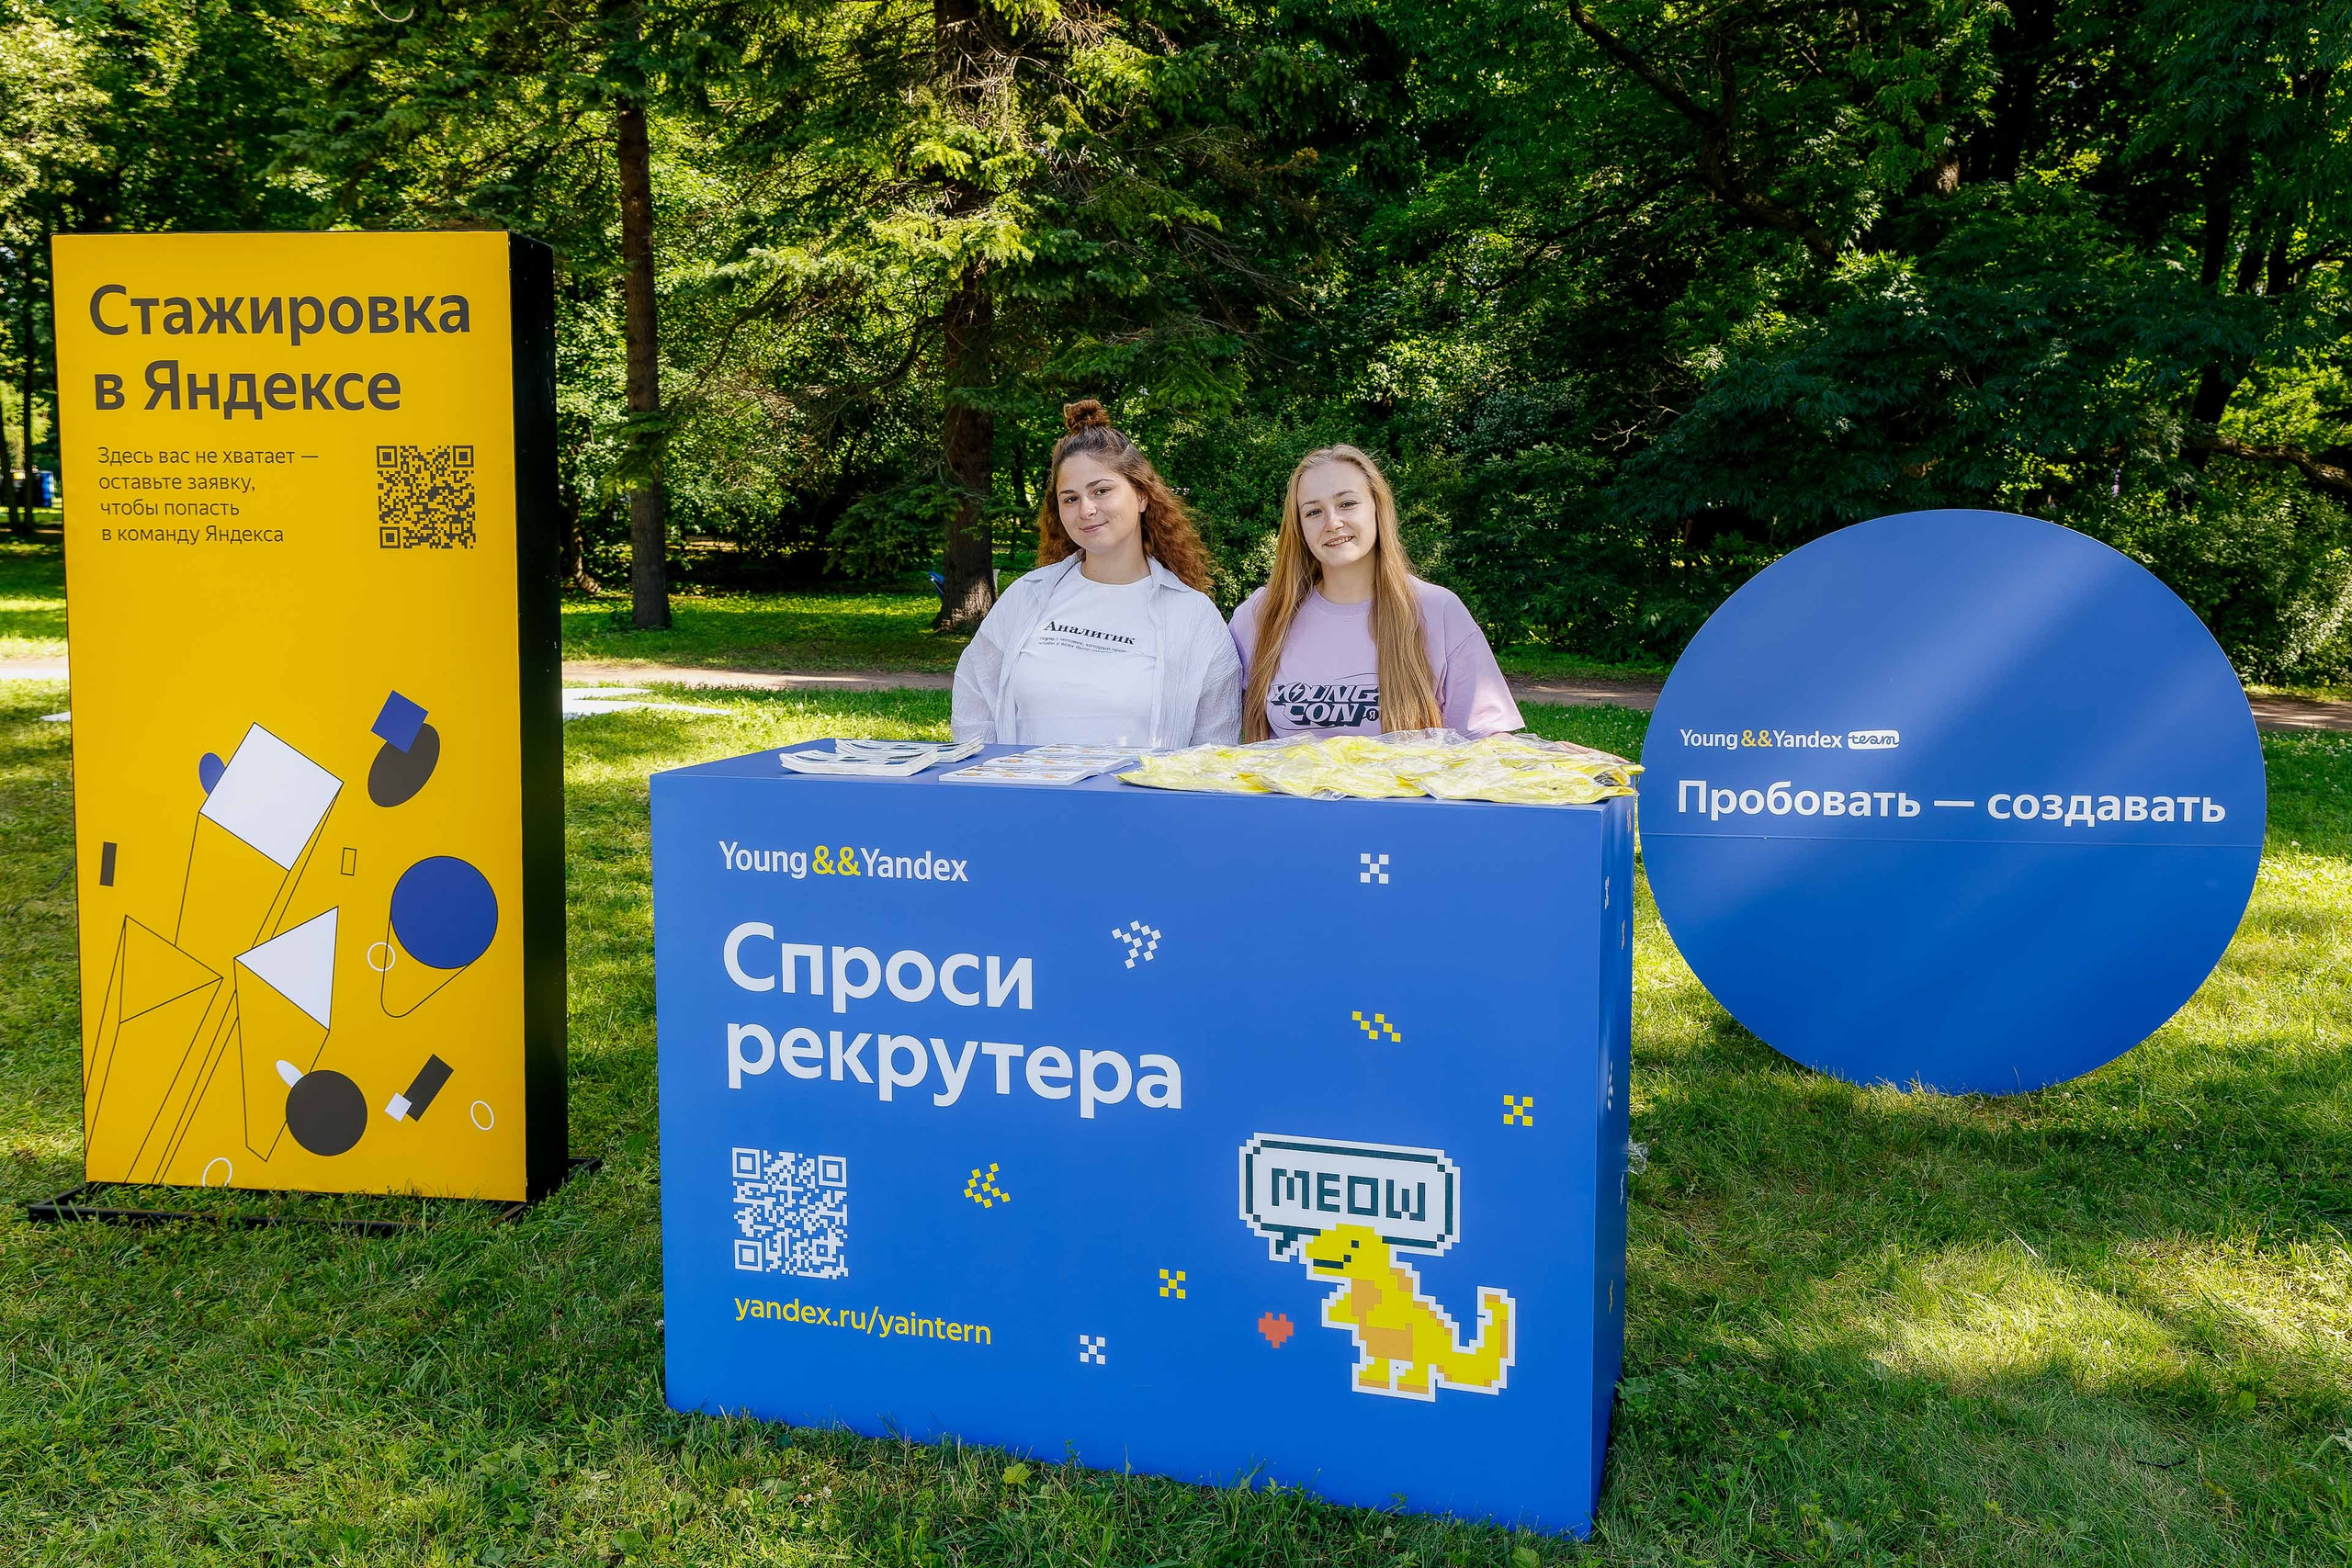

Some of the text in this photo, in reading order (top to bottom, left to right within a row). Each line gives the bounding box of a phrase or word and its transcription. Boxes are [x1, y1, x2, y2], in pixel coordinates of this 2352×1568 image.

[89, 283, 471, 347] Стажировка
[94, 359, 401, 421] в Яндексе
[97, 446, 153, 467] Здесь
[158, 450, 190, 464] вас
[196, 450, 219, 464] не
[222, 450, 295, 465] хватает
[98, 476, 255, 493] оставьте заявку,
[100, 499, 240, 516] чтобы попасть
[102, 525, 284, 545] в команду Яндекса
[1044, 621, 1136, 645] Аналитик
[1270, 682, 1380, 703] YOUNG
[1283, 702, 1360, 724] CON
[1679, 728, 1900, 750] Young&&Yandex team
[1678, 780, 1921, 821] Пробовать
[1987, 794, 2226, 828] создавать
[718, 840, 968, 883] Young&&Yandex
[722, 921, 1033, 1014] Спроси
[726, 1021, 1182, 1120] рекрутера
[1271, 1168, 1426, 1223] MEOW
[734, 1297, 992, 1345] yandex.ru/yaintern
